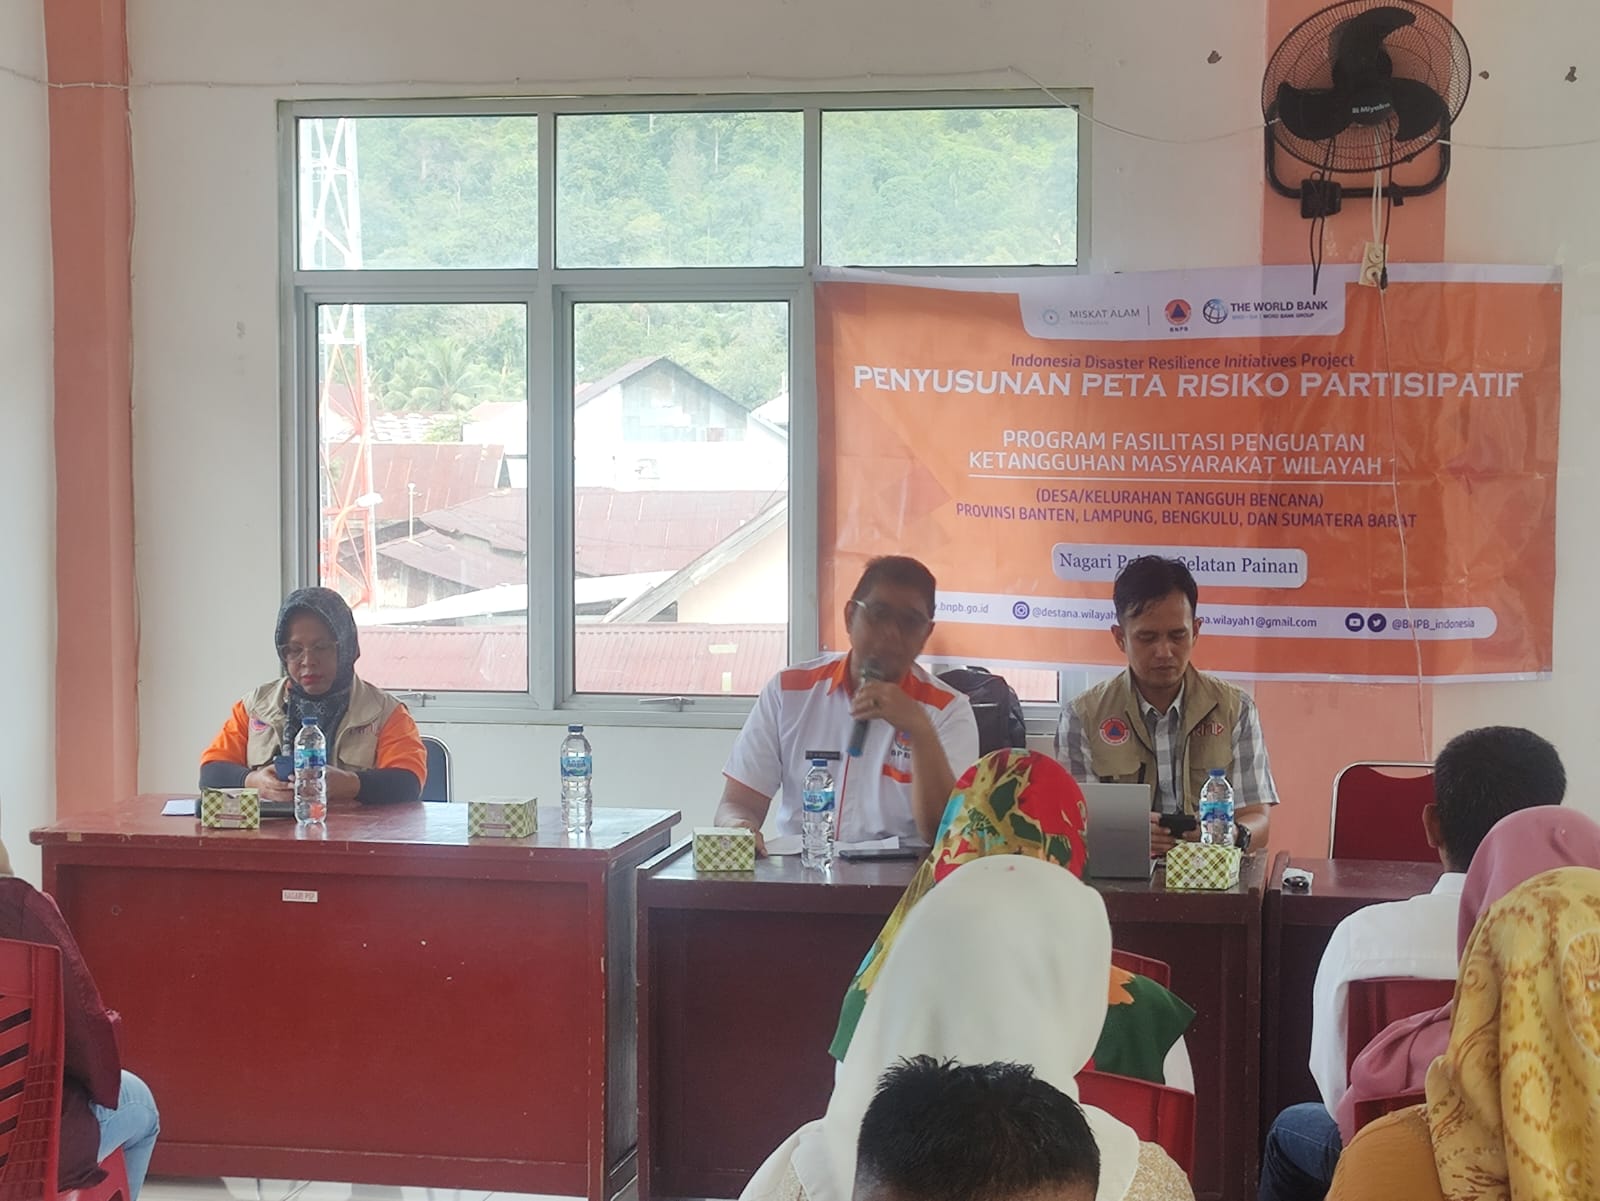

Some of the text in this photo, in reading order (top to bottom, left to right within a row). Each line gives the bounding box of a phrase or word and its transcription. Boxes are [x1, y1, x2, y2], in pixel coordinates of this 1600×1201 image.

[1069, 309, 1140, 318] MISKAT ALAM
[1230, 301, 1328, 312] THE WORLD BANK
[1011, 353, 1354, 370] Indonesia Disaster Resilience Initiatives Project
[854, 365, 1524, 398] PENYUSUNAN PETA RISIKO PARTISIPATIF
[1003, 430, 1365, 452] PROGRAM FASILITASI PENGUATAN
[969, 451, 1382, 475] KETANGGUHAN MASYARAKAT WILAYAH
[1036, 488, 1324, 508] (DESA/KELURAHAN TANGGUH BENCANA)
[956, 503, 1417, 528] PROVINSI BANTEN, LAMPUNG, BENGKULU, DAN SUMATERA BARAT
[1059, 553, 1112, 572] Nagari
[1241, 558, 1298, 574] Painan
[934, 601, 989, 614] .bnpb.go.id
